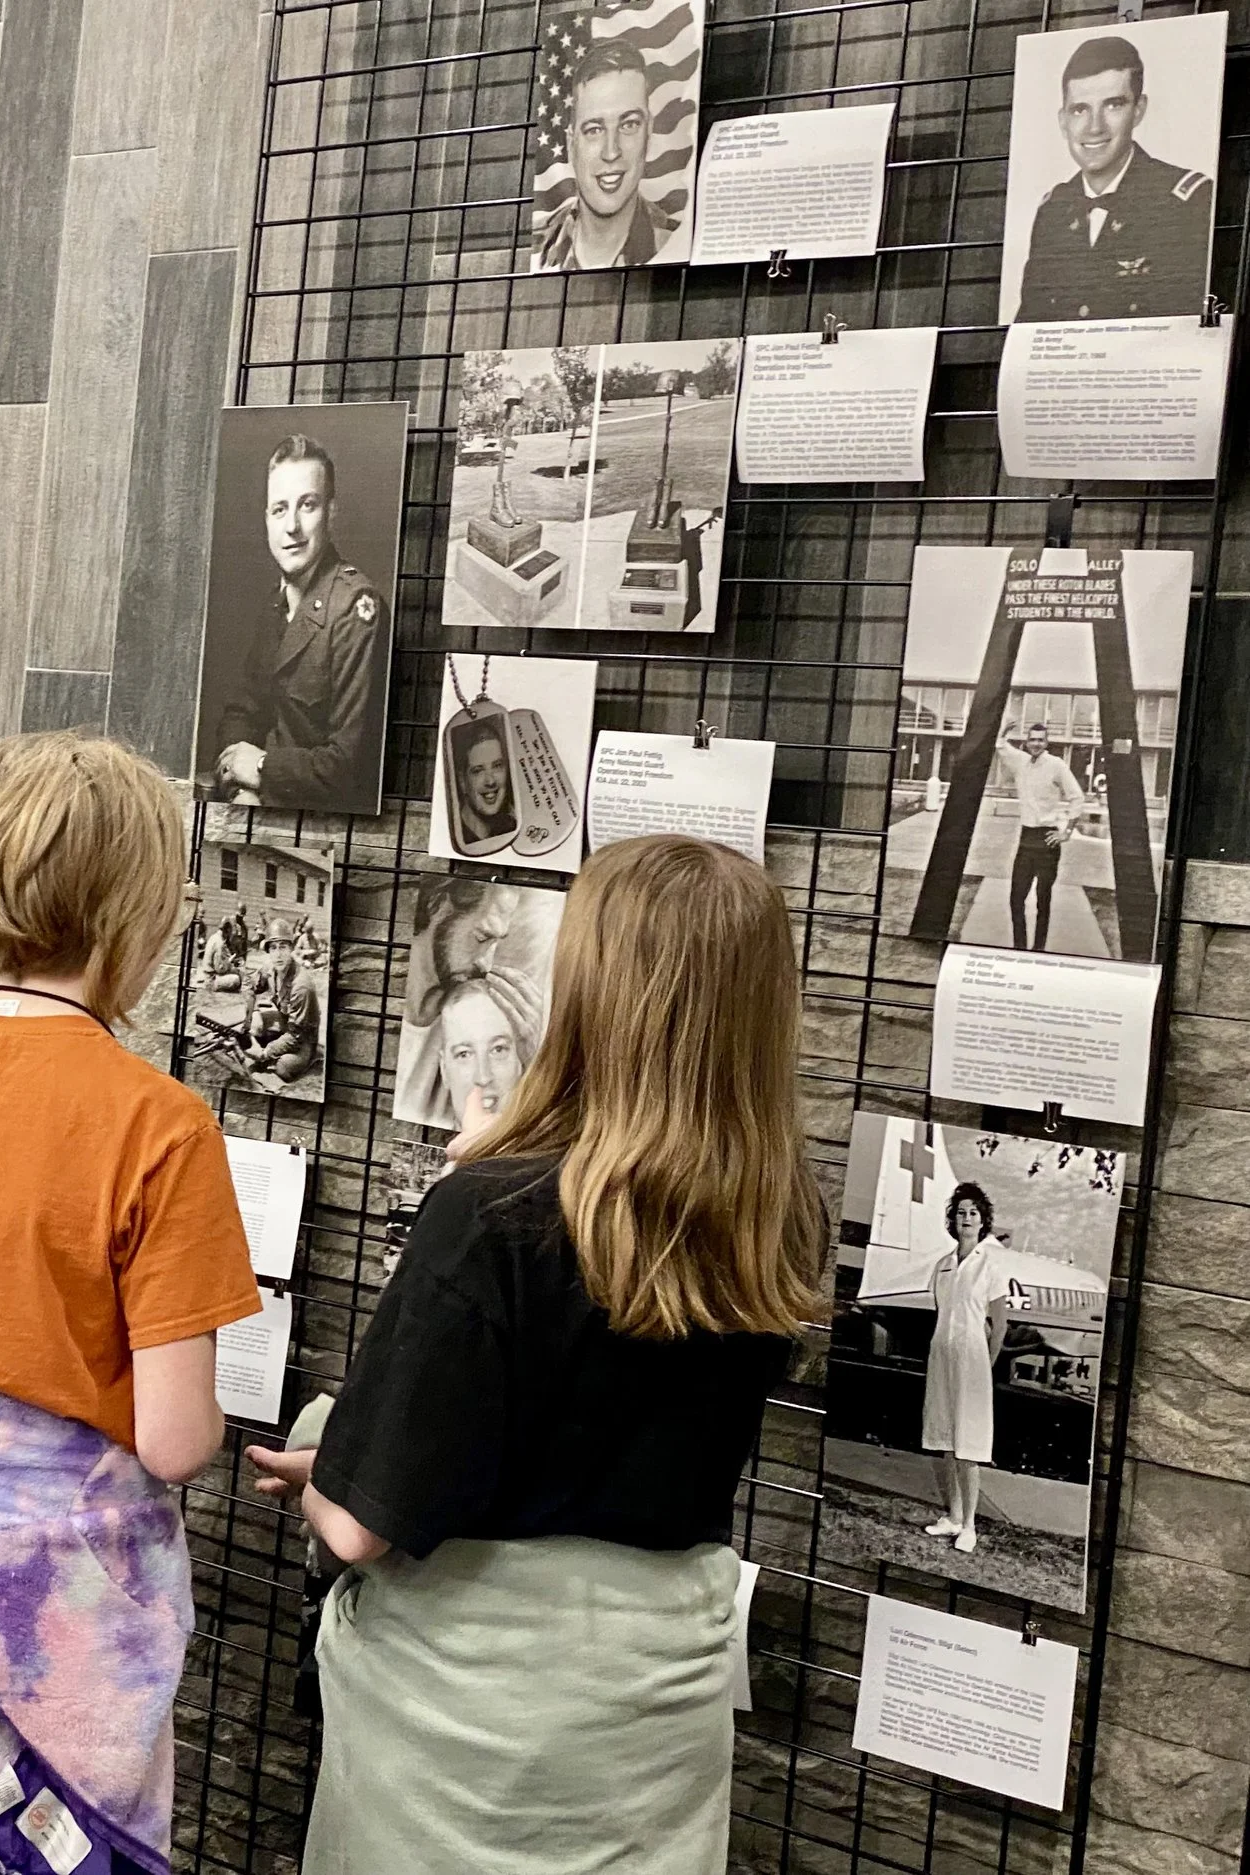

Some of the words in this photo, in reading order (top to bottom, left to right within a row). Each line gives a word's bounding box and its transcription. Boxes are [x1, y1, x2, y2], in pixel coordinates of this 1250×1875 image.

[1010, 559, 1038, 572] SOLO
[1088, 560, 1122, 571] ALLEY
[1007, 579, 1032, 591] UNDER
[1033, 579, 1057, 590] THESE
[1084, 579, 1116, 591] BLADES
[1005, 593, 1026, 605] PASS
[1027, 593, 1043, 604] THE
[1044, 593, 1070, 604] FINEST
[1070, 593, 1119, 605] HELICOPTER
[1007, 606, 1052, 619] STUDENTS
[1054, 607, 1065, 618] IN
[1067, 606, 1083, 618] THE
[644, 750, 663, 760] Fettig
[599, 757, 615, 766] Army
[617, 759, 643, 767] National
[644, 761, 664, 769] Guard
[597, 766, 627, 775] Operation
[629, 768, 643, 778] Iraqi
[645, 770, 674, 779] Freedom
[890, 1635, 899, 1643] US
[910, 1641, 928, 1651] Force
